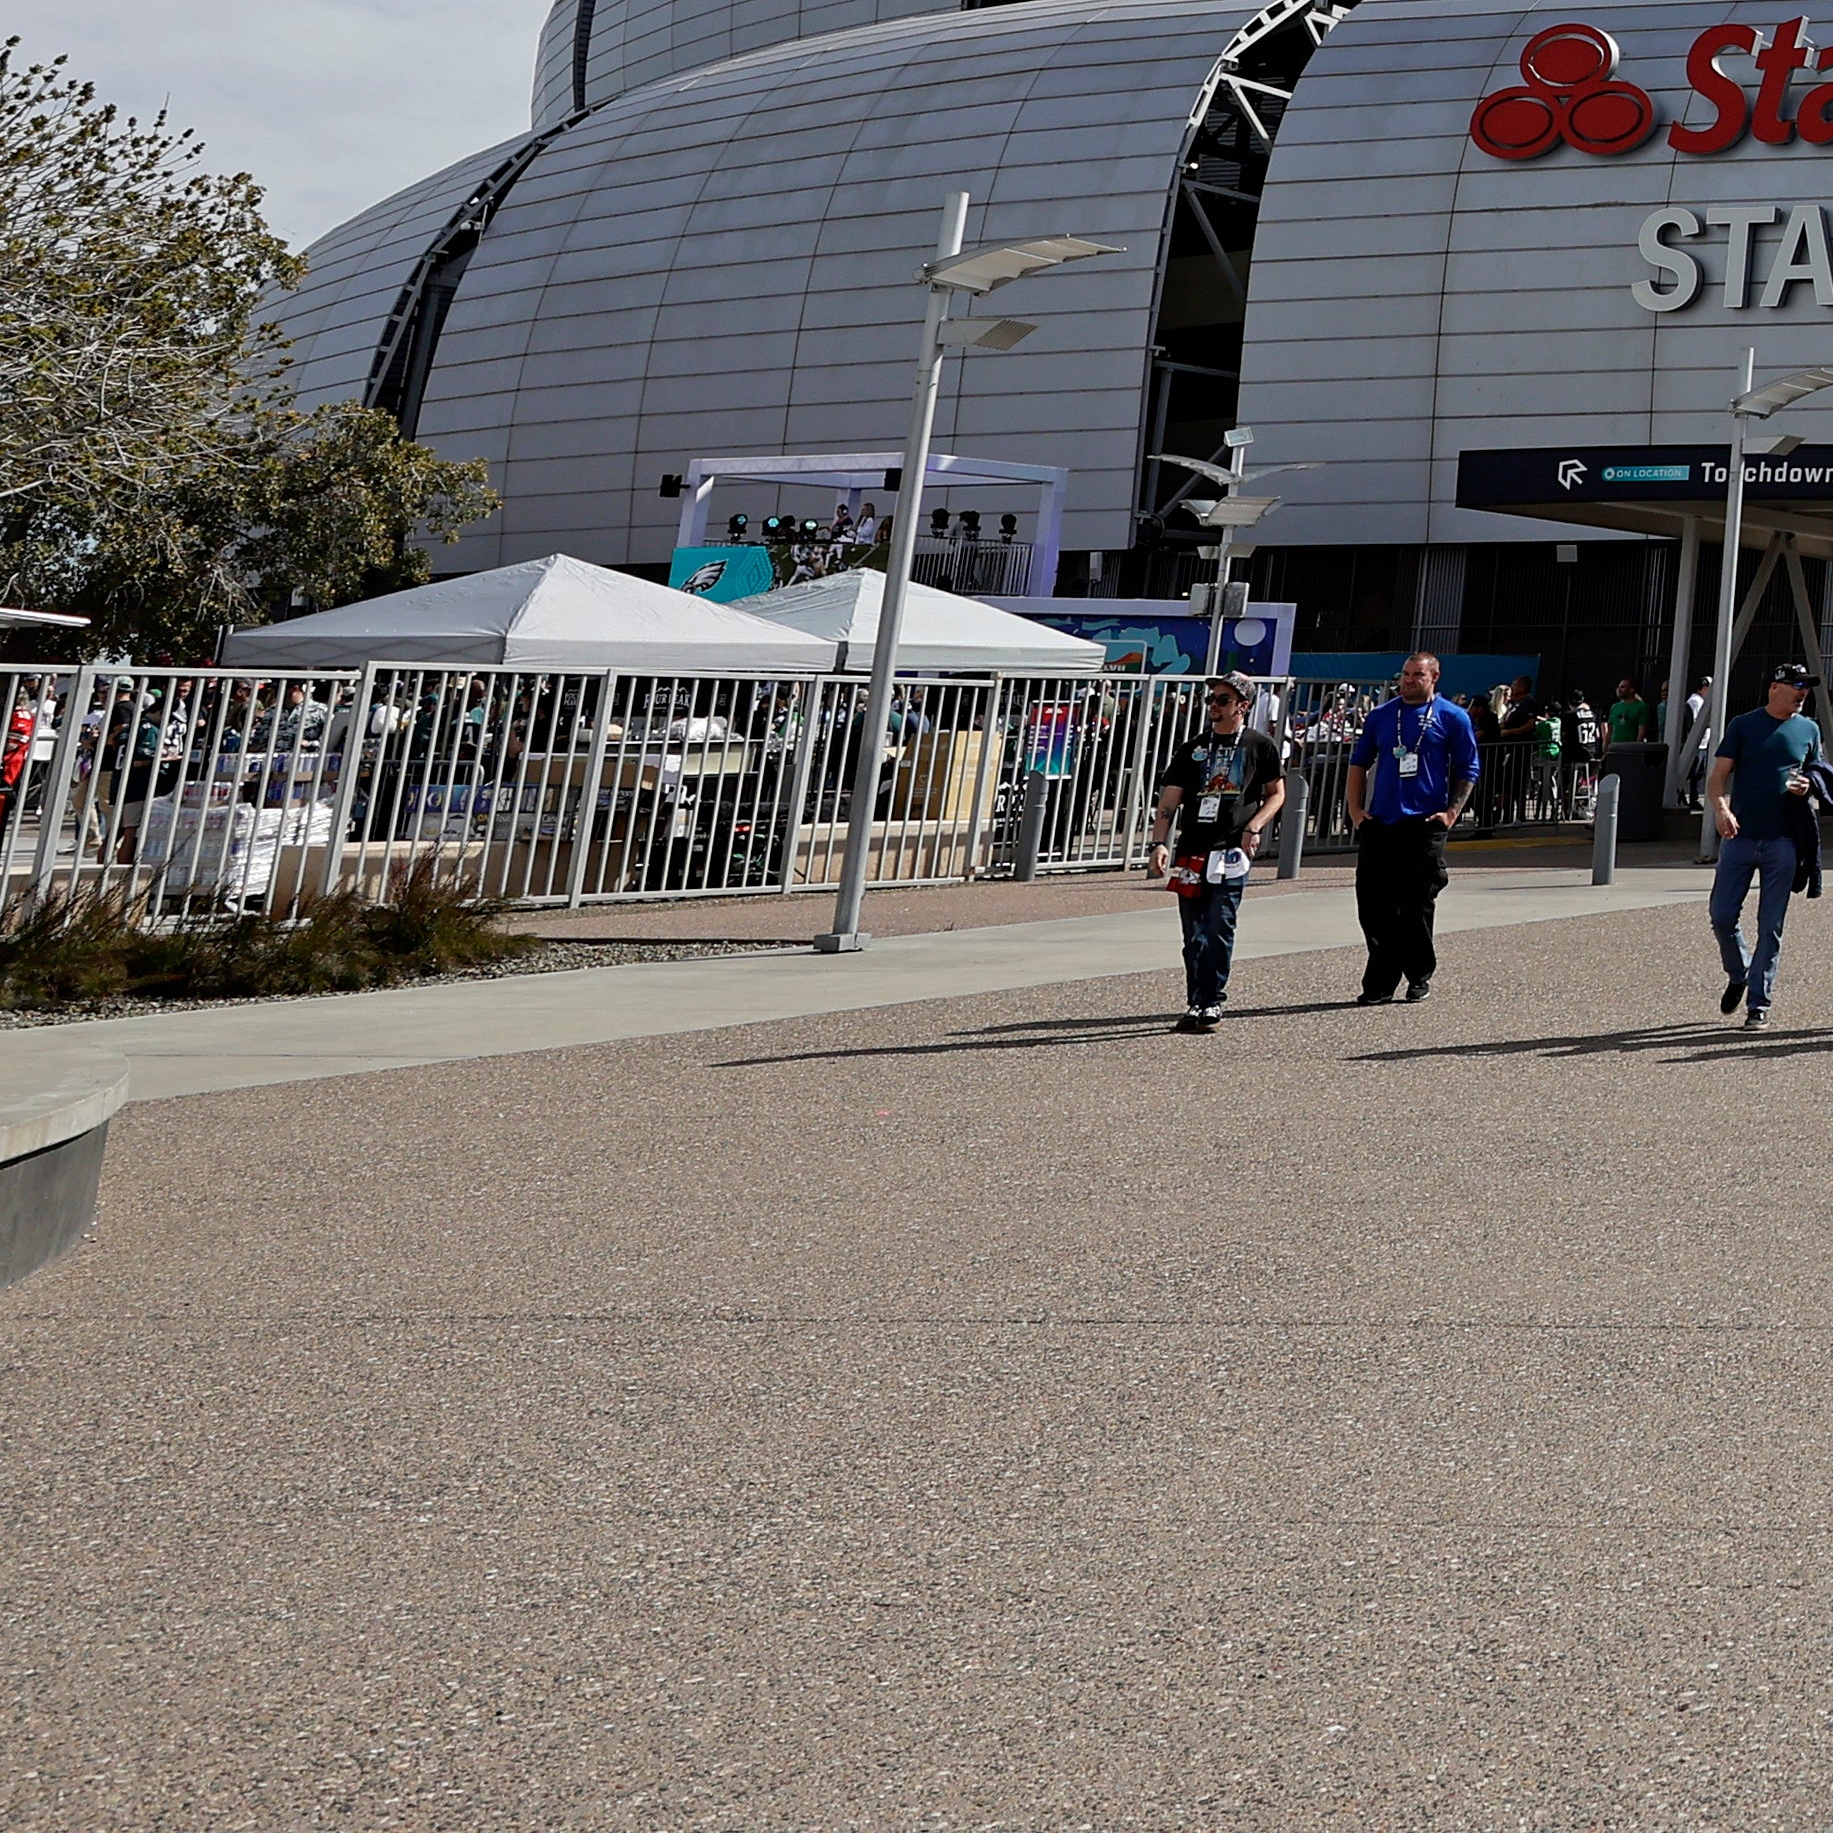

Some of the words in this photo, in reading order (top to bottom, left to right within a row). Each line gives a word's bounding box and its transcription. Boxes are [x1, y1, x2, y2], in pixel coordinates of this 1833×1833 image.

[1616, 469, 1631, 479] ON
[1634, 467, 1683, 479] LOCATION
[643, 693, 668, 709] FUR
[1577, 722, 1596, 744] 62
